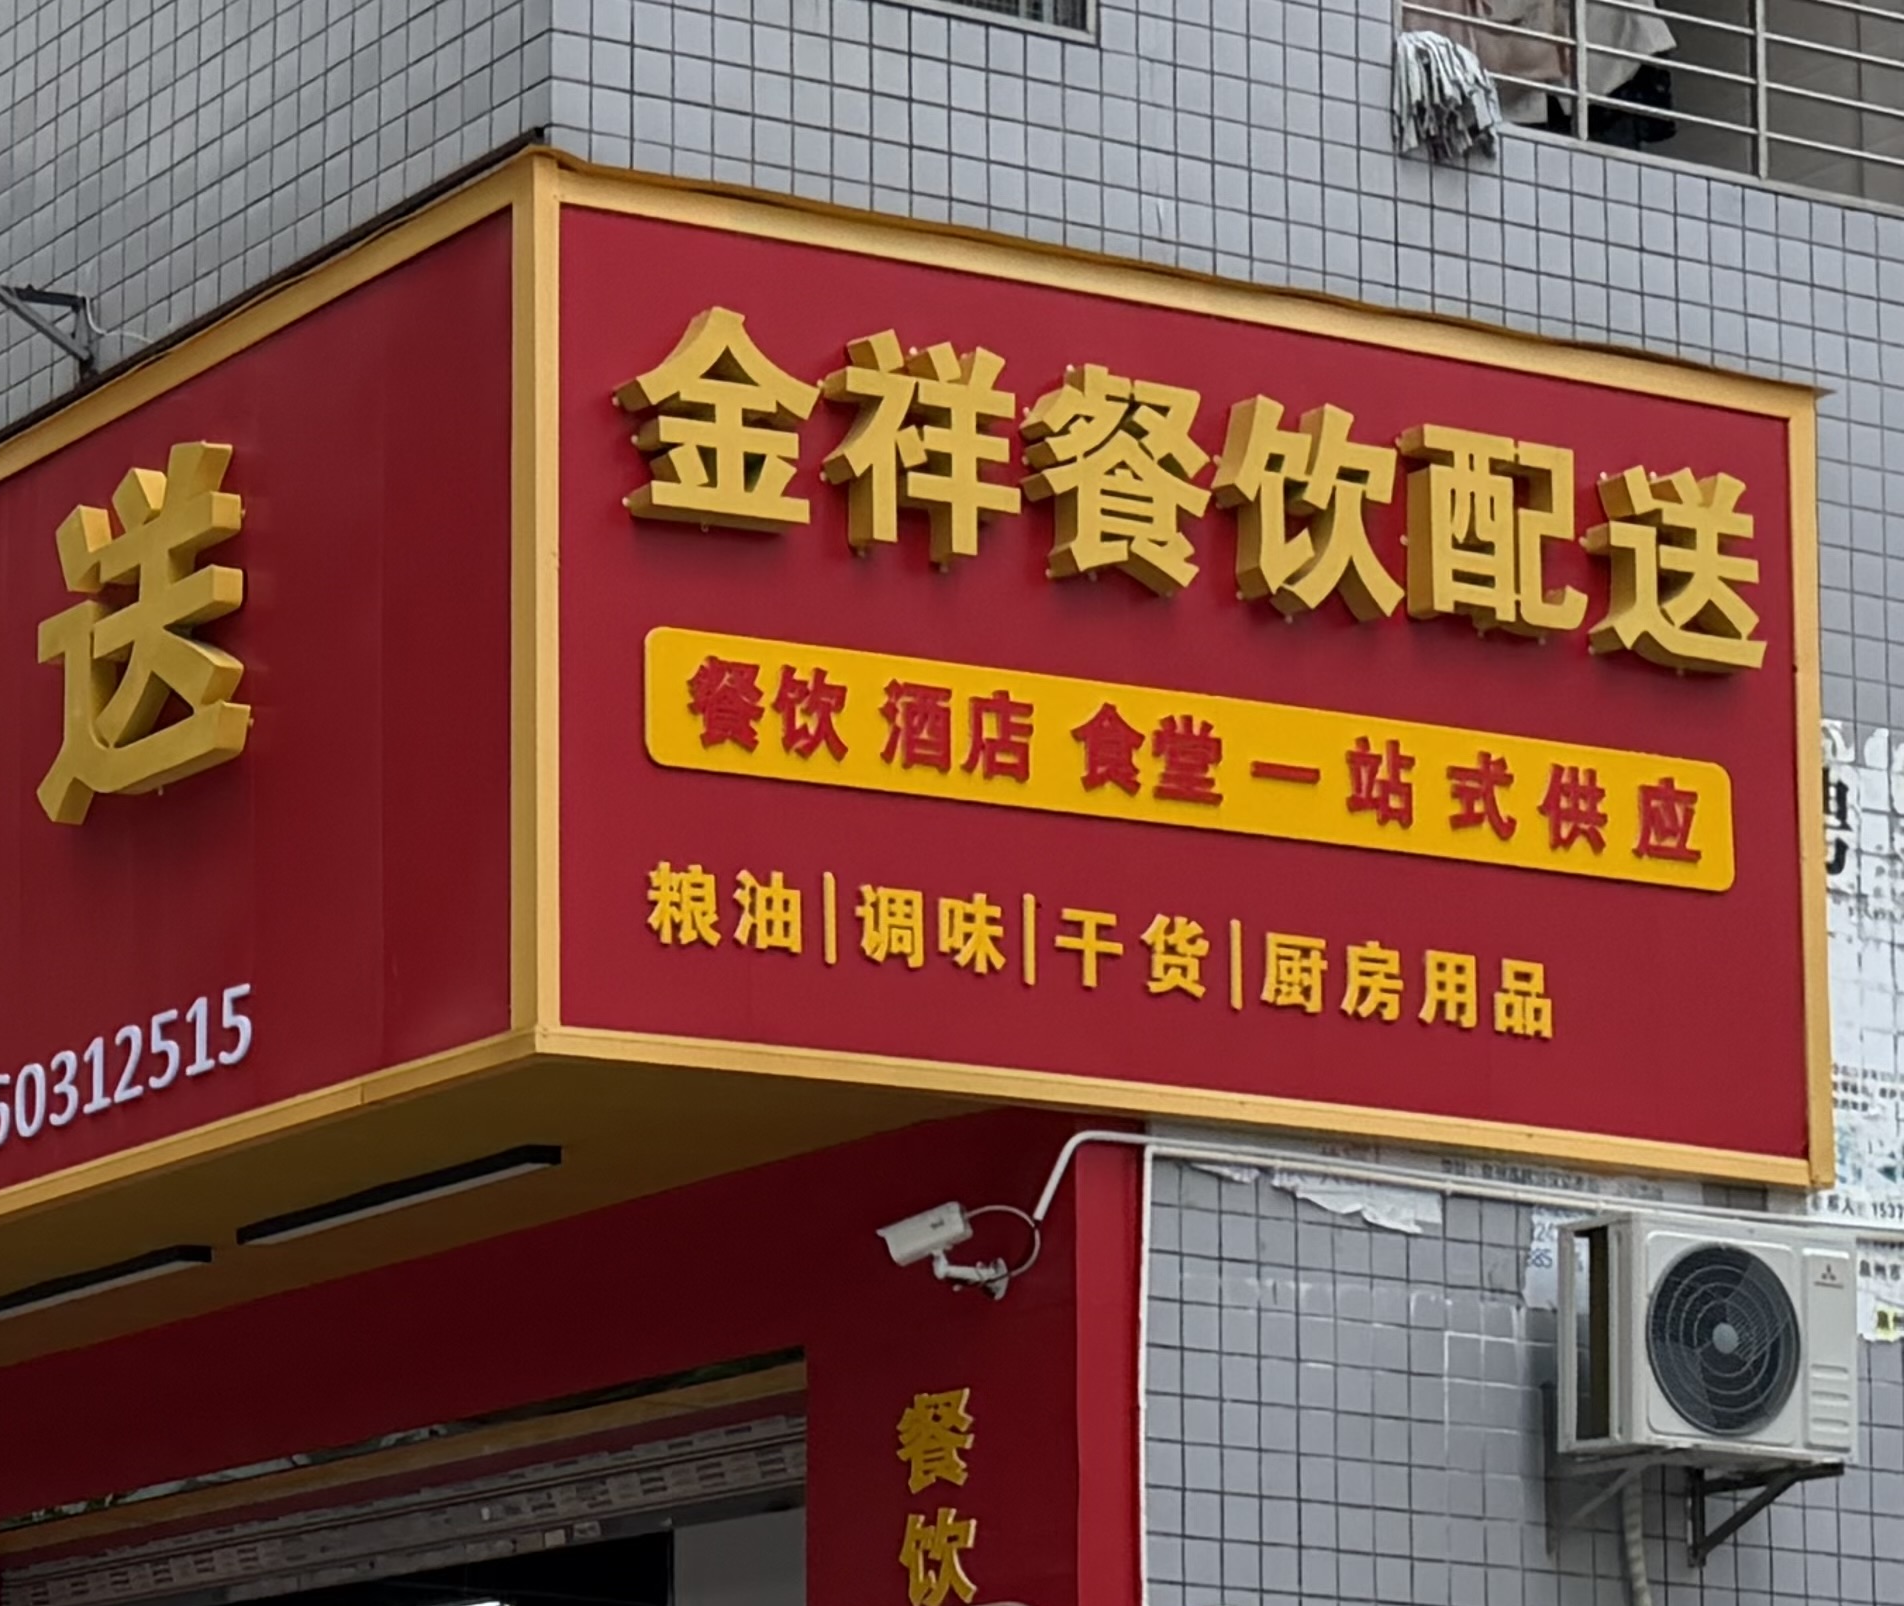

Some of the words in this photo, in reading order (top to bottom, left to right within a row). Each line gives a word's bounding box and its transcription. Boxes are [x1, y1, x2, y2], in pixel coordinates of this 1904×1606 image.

[611, 304, 1768, 674] 金祥餐饮配送
